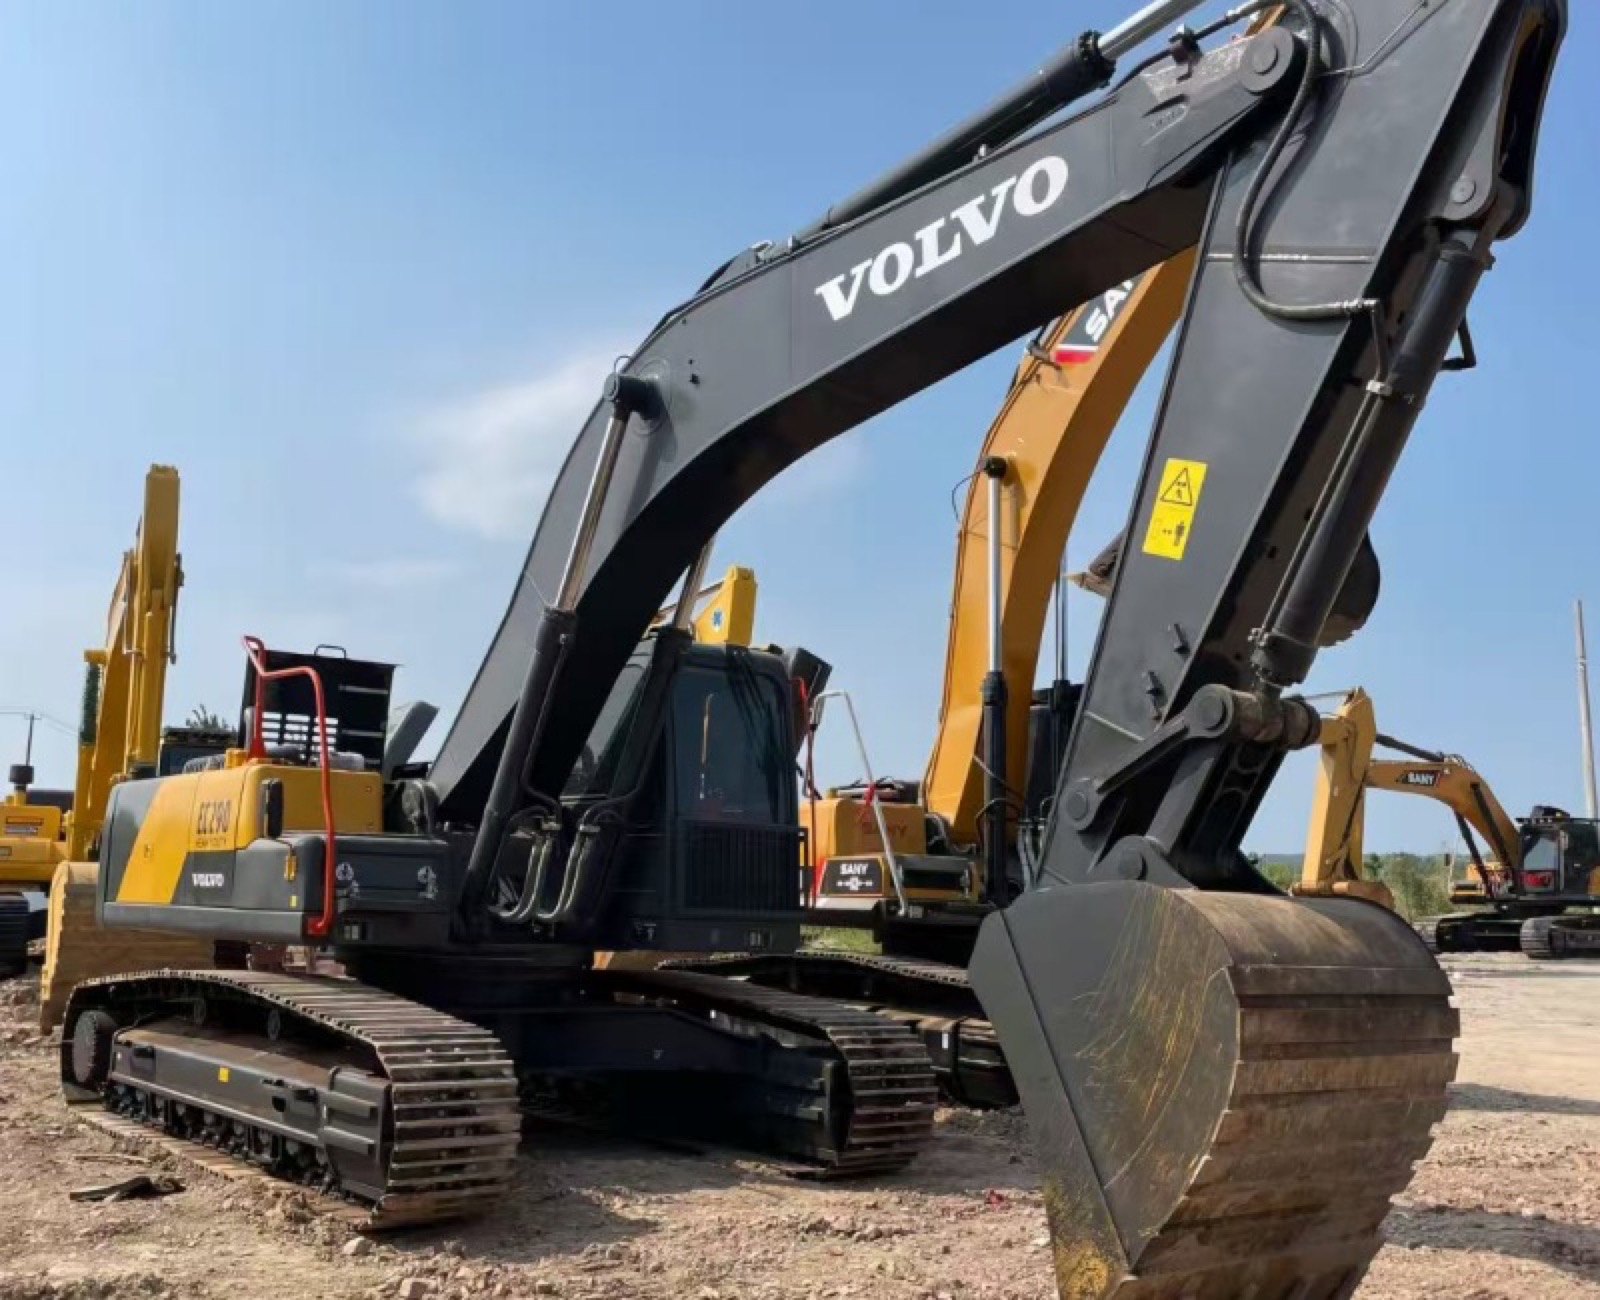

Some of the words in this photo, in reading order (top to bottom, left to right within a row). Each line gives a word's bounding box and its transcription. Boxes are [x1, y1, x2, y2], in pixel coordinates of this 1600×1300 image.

[814, 155, 1069, 321] VOLVO
[1085, 280, 1133, 342] SA
[192, 873, 225, 887] VOLVO
[840, 863, 868, 875] SANY
